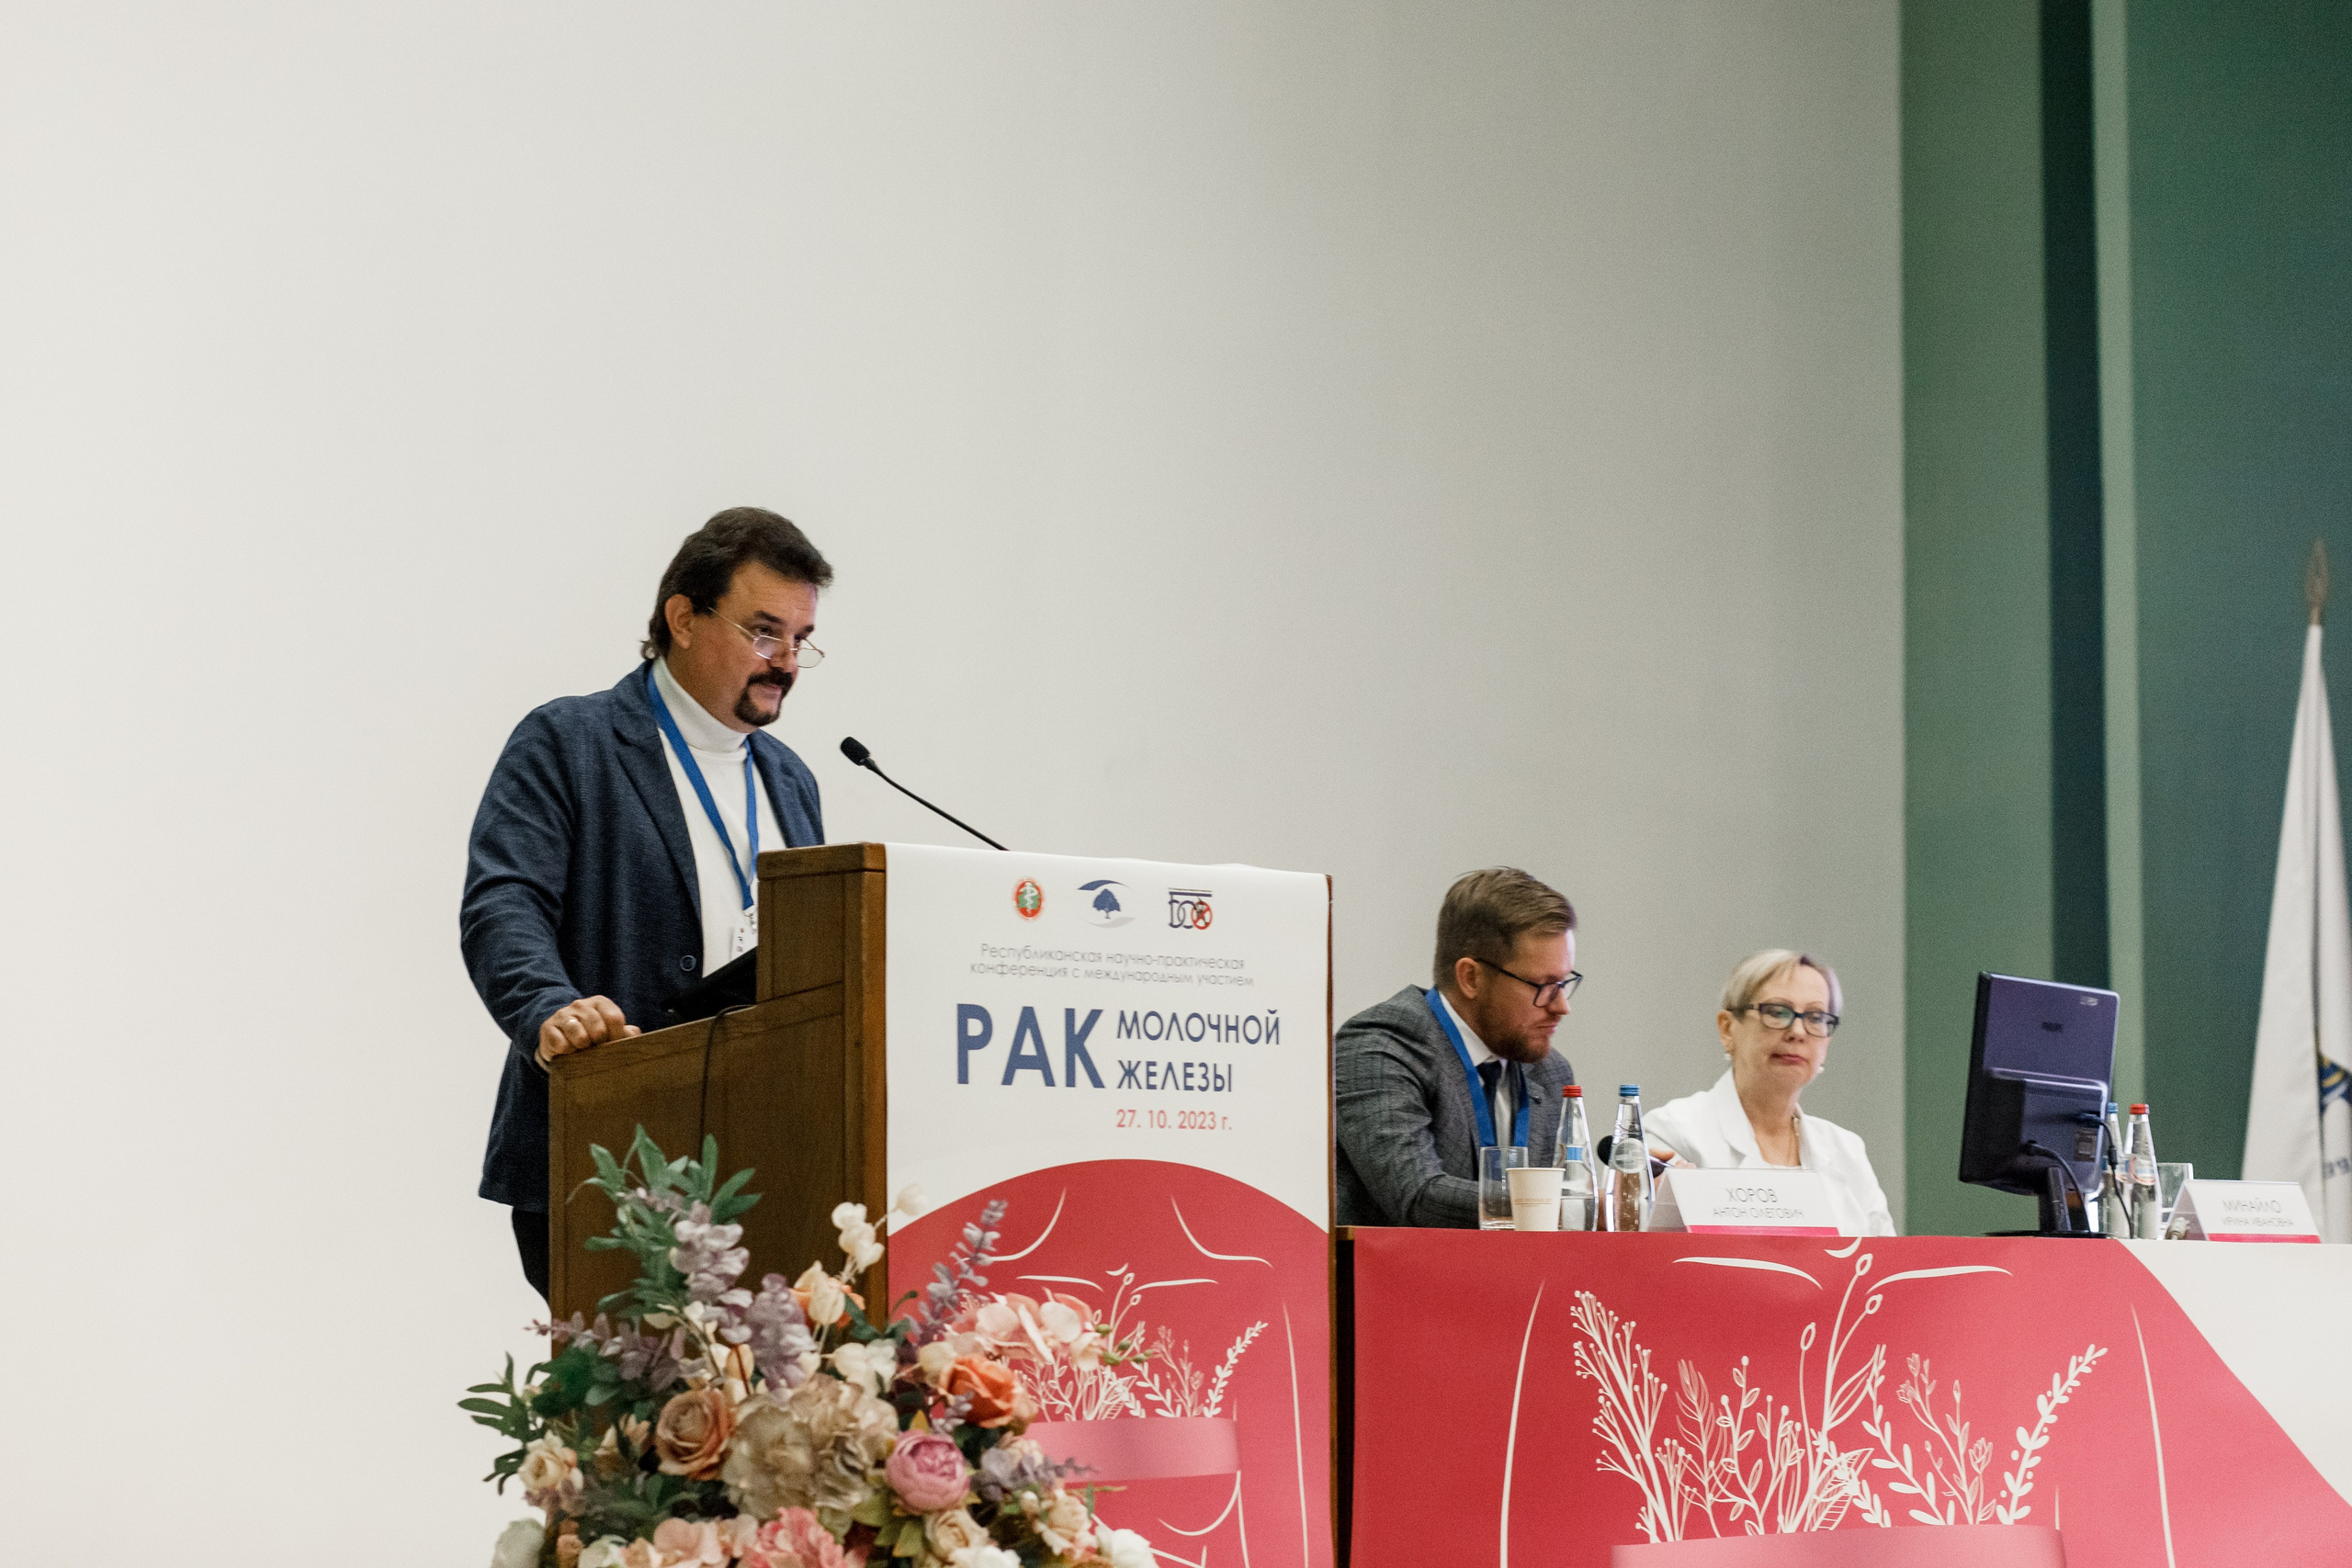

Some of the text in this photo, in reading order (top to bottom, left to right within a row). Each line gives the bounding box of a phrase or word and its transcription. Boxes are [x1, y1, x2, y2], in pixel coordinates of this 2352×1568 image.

[980, 942, 1245, 970] Республиканская научно-практическая
[970, 961, 1255, 987] конференция с международным участием
[1116, 1009, 1280, 1045] МОЛОЧНОЙ
[956, 1002, 1106, 1089] РАК
[1116, 1059, 1232, 1092] ЖЕЛЕЗЫ
[1177, 1110, 1216, 1130] 2023
[1221, 1116, 1232, 1131] г.
[1725, 1187, 1778, 1203] ХОРОВ
[1713, 1207, 1804, 1219] АНТОН ОЛЕГОВИЧ
